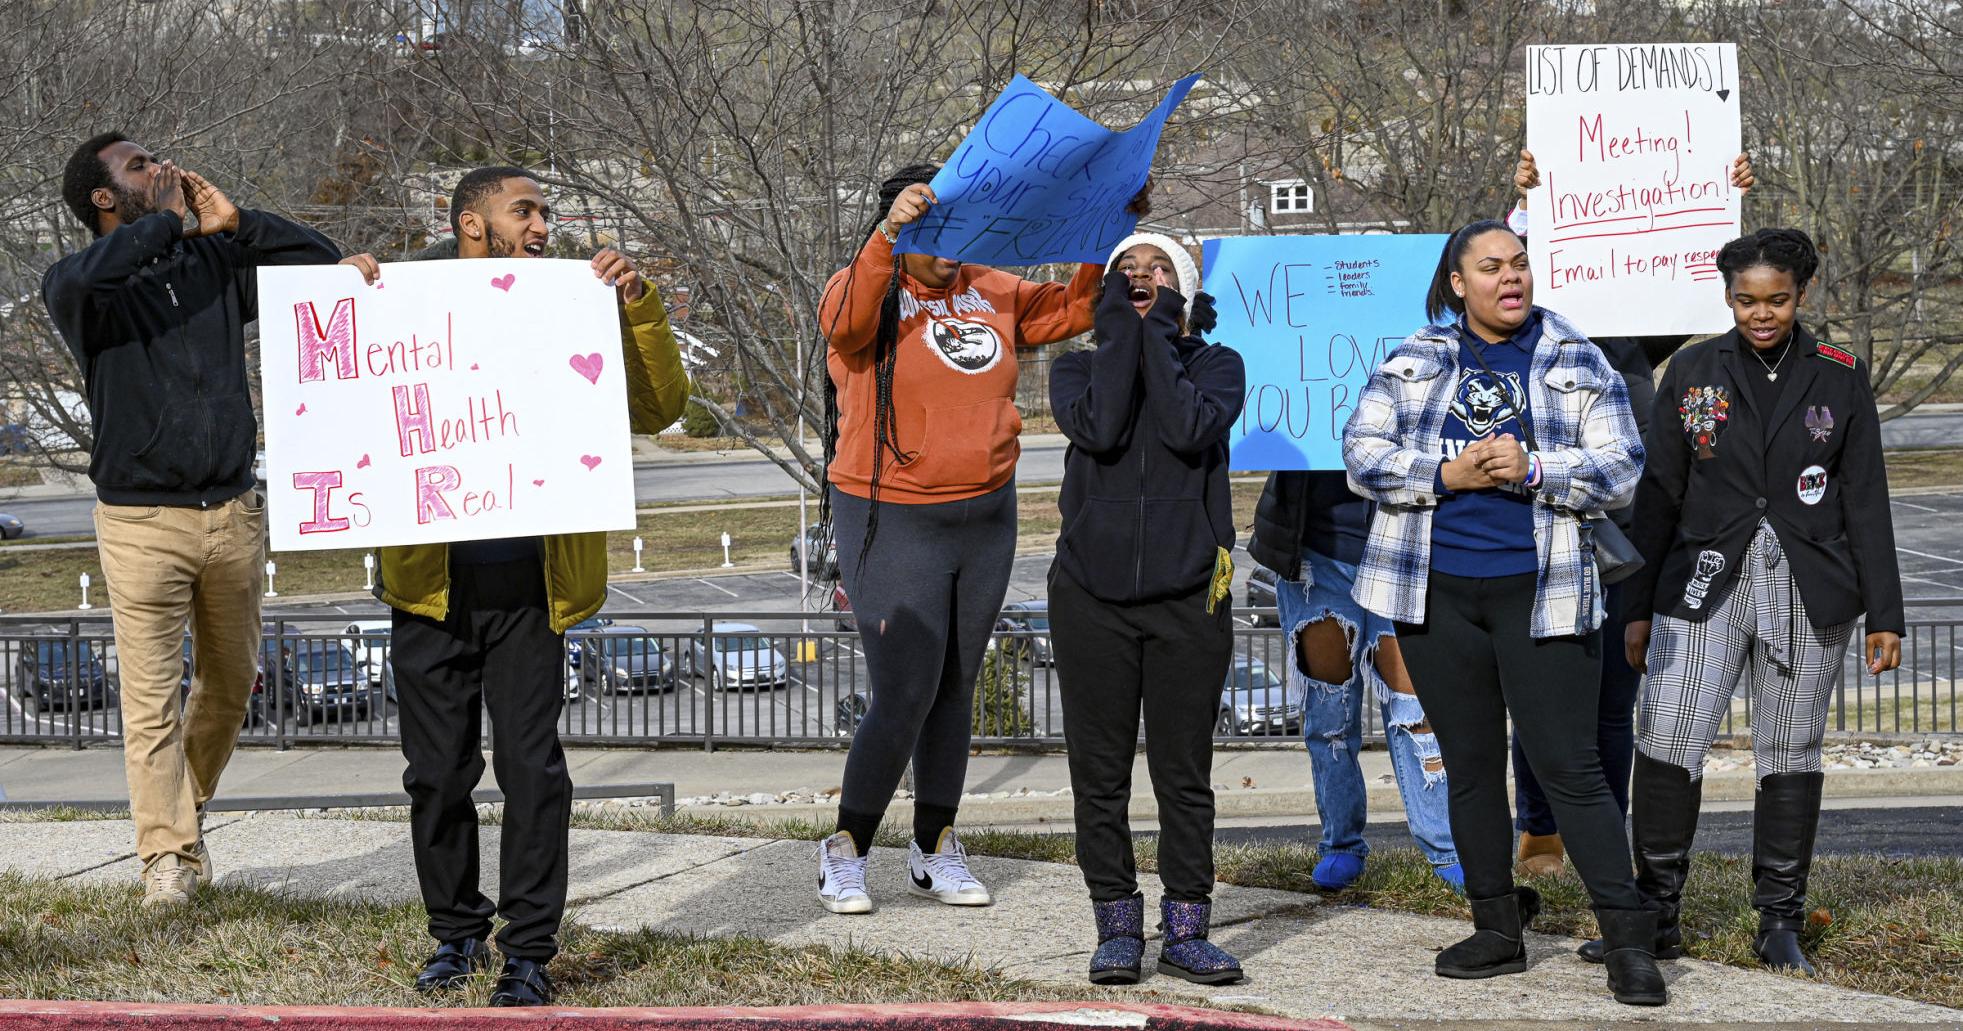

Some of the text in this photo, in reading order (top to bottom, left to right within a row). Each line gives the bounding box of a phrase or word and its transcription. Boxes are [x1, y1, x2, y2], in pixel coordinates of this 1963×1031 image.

[1529, 46, 1566, 95] LIST
[1577, 47, 1607, 92] OF
[943, 144, 1047, 214] your
[1579, 110, 1692, 185] Meeting!
[1549, 165, 1730, 232] Investigation!
[1231, 262, 1312, 327] WE
[1550, 248, 1616, 289] Email
[1624, 253, 1648, 275] to
[1652, 253, 1678, 280] pay
[294, 297, 453, 384] Mental
[392, 382, 519, 457] Health
[293, 463, 513, 535] Is Real
